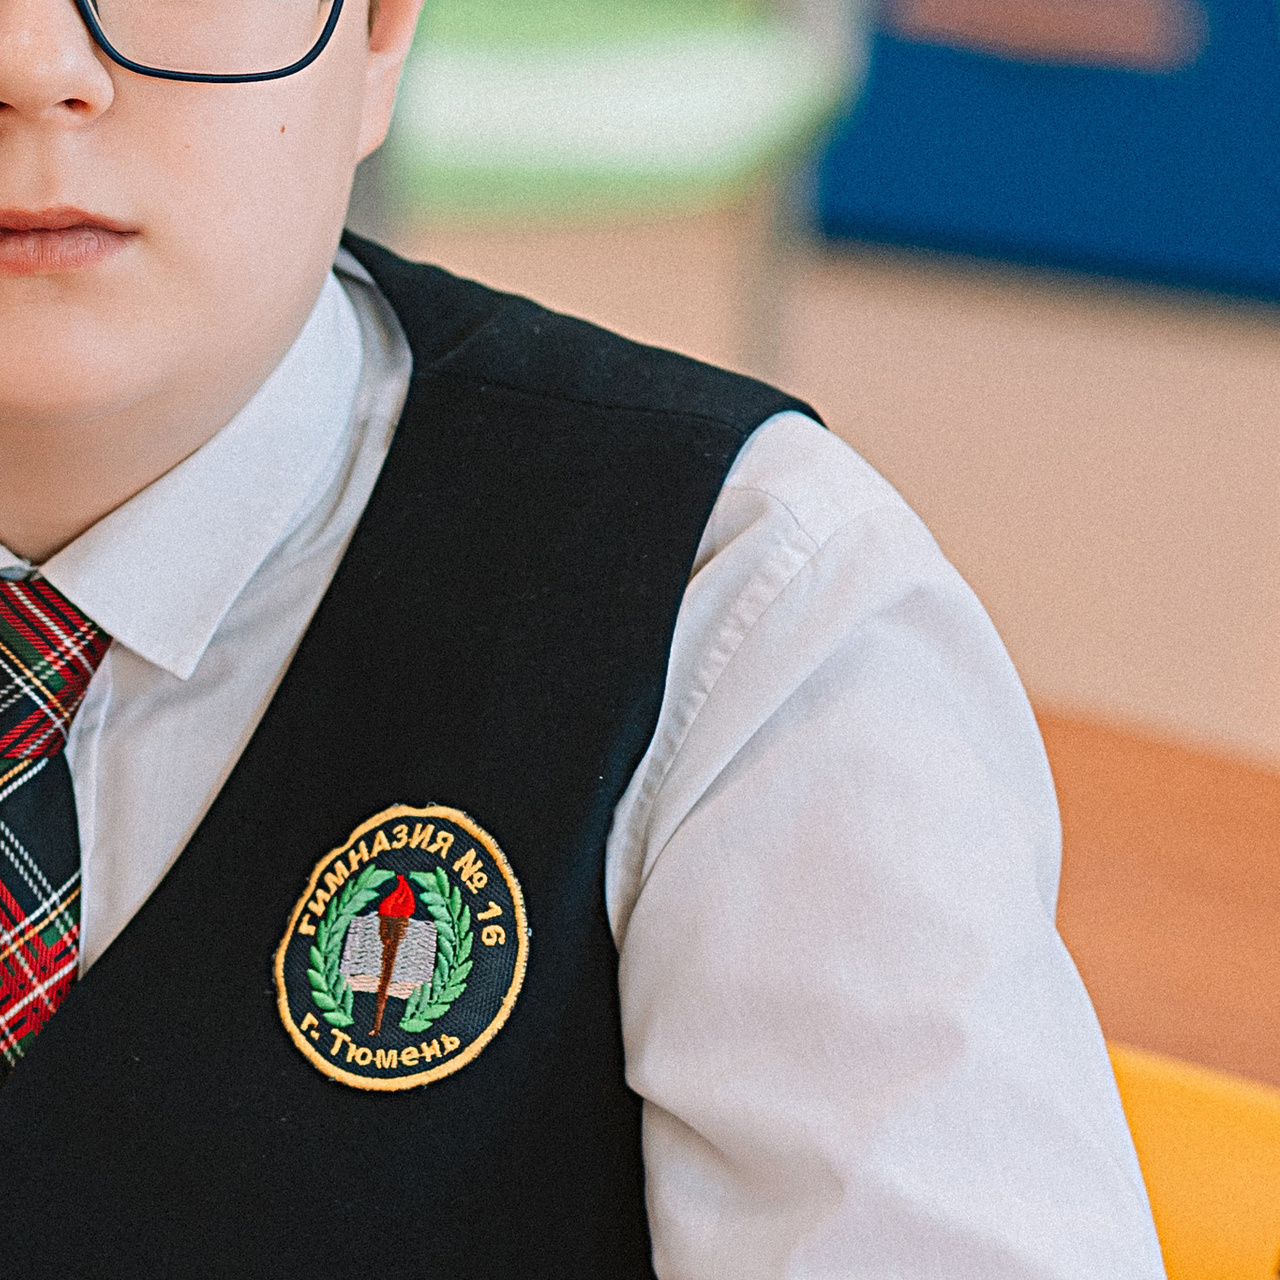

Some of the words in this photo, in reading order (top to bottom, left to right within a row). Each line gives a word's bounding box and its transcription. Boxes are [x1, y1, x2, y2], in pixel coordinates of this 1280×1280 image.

[298, 823, 454, 936] ГИМНАЗИЯ
[452, 848, 488, 894] №
[477, 901, 506, 946] 16
[330, 1028, 461, 1069] Тюмень
